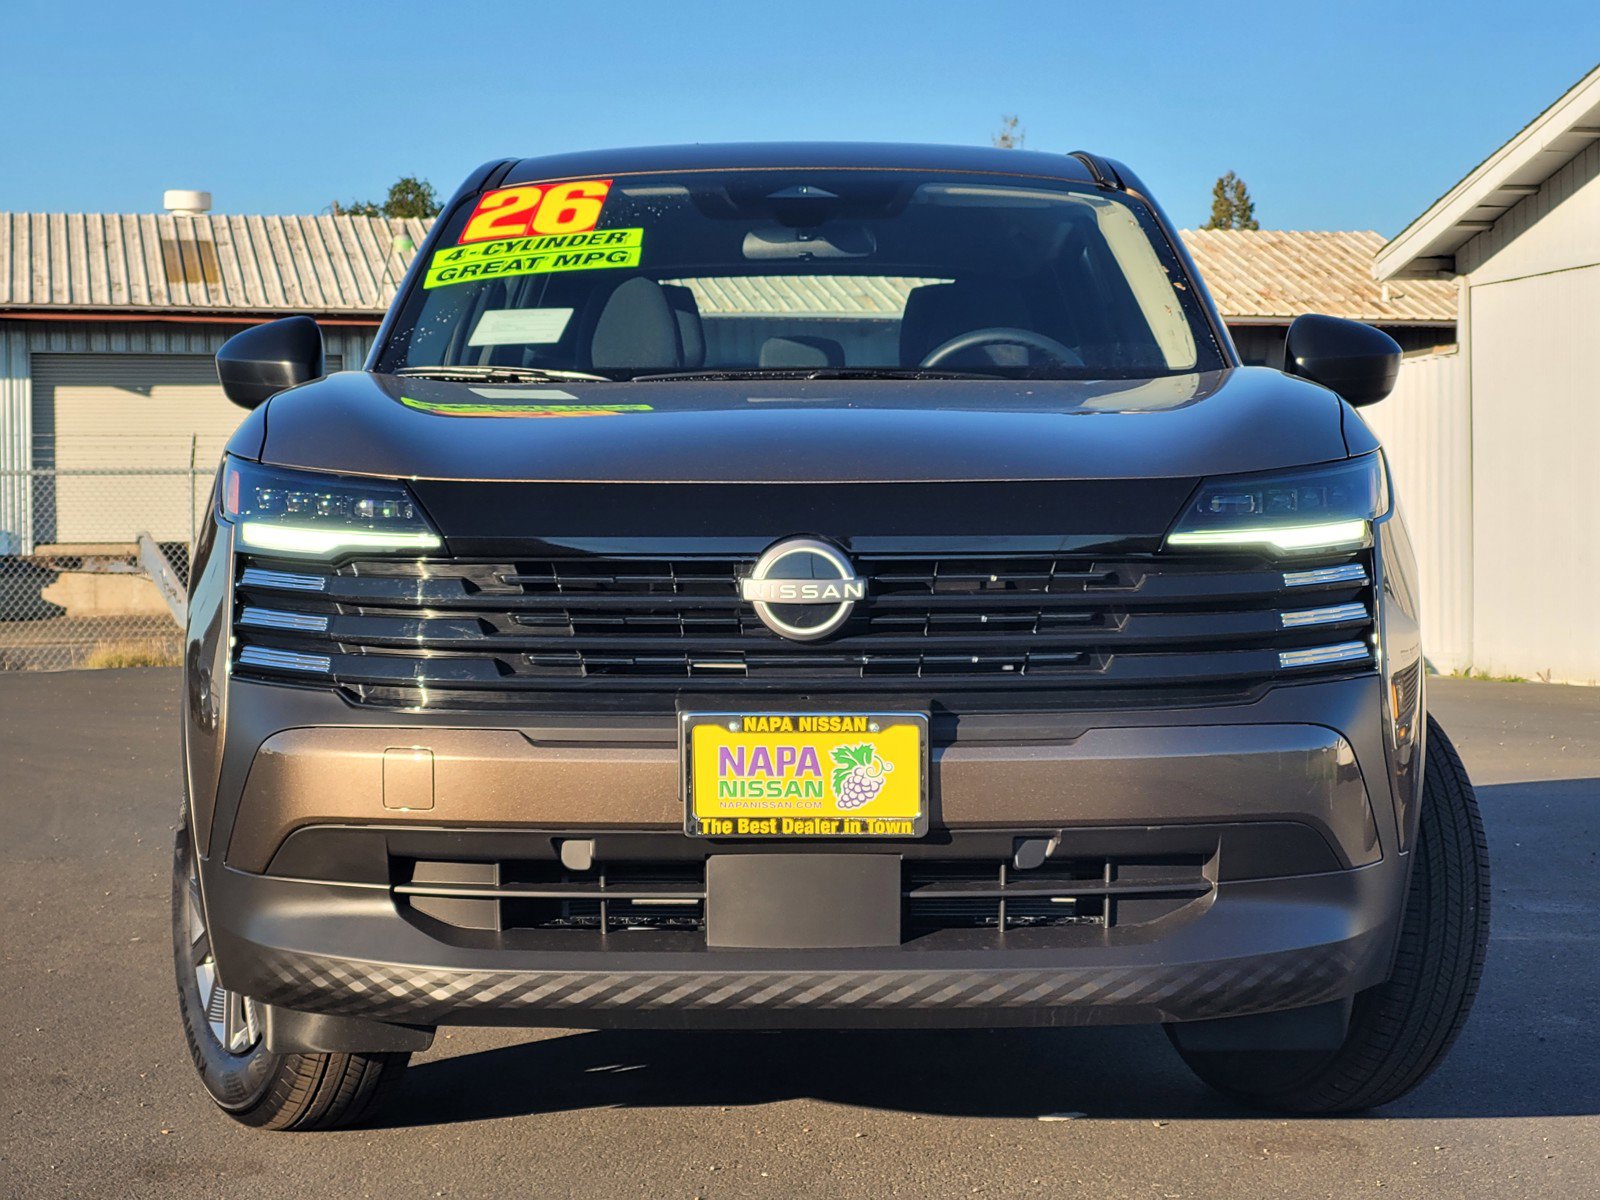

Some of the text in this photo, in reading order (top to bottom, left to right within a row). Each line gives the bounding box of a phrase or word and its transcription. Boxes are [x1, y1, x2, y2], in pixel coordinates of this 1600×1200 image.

[463, 181, 609, 242] 26
[444, 231, 631, 262] 4-CYLINDER
[436, 250, 631, 282] GREAT MPG
[746, 582, 863, 599] NISSAN
[743, 716, 867, 732] NAPA NISSAN
[719, 746, 822, 777] NAPA
[719, 780, 823, 798] NISSAN
[719, 801, 822, 809] NAPANISSAN.COM
[701, 818, 912, 835] The Best Dealer in Town
